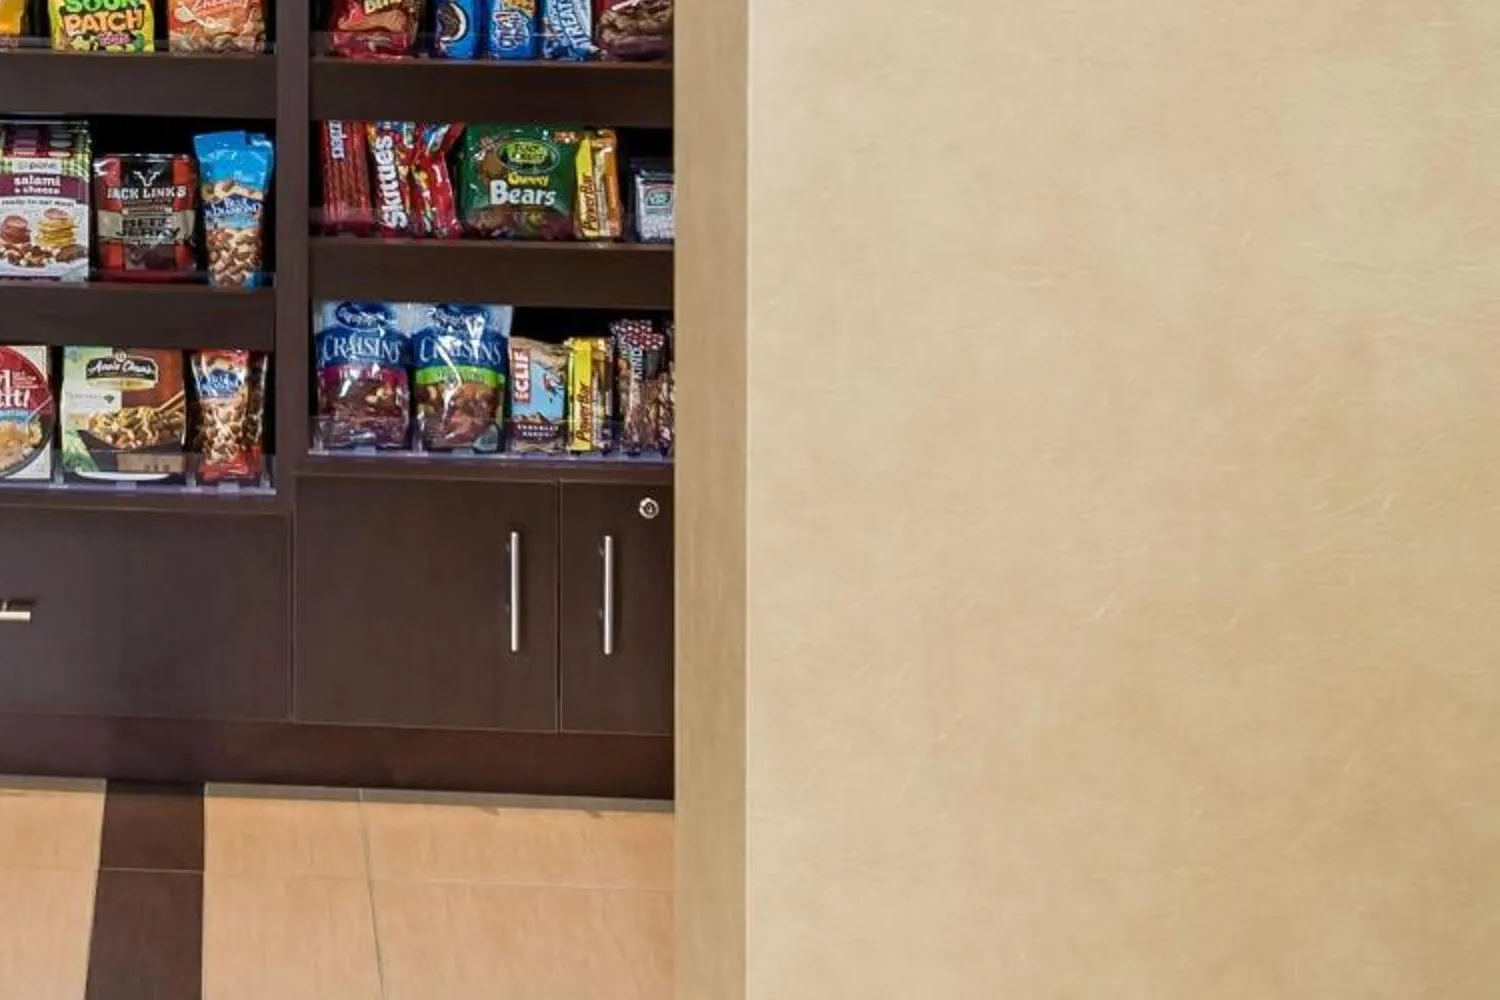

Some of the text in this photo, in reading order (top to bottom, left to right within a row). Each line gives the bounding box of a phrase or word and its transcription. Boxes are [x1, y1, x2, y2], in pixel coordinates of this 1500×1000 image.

[63, 8, 144, 36] PATCH
[14, 174, 61, 187] salami
[489, 179, 557, 206] Bears
